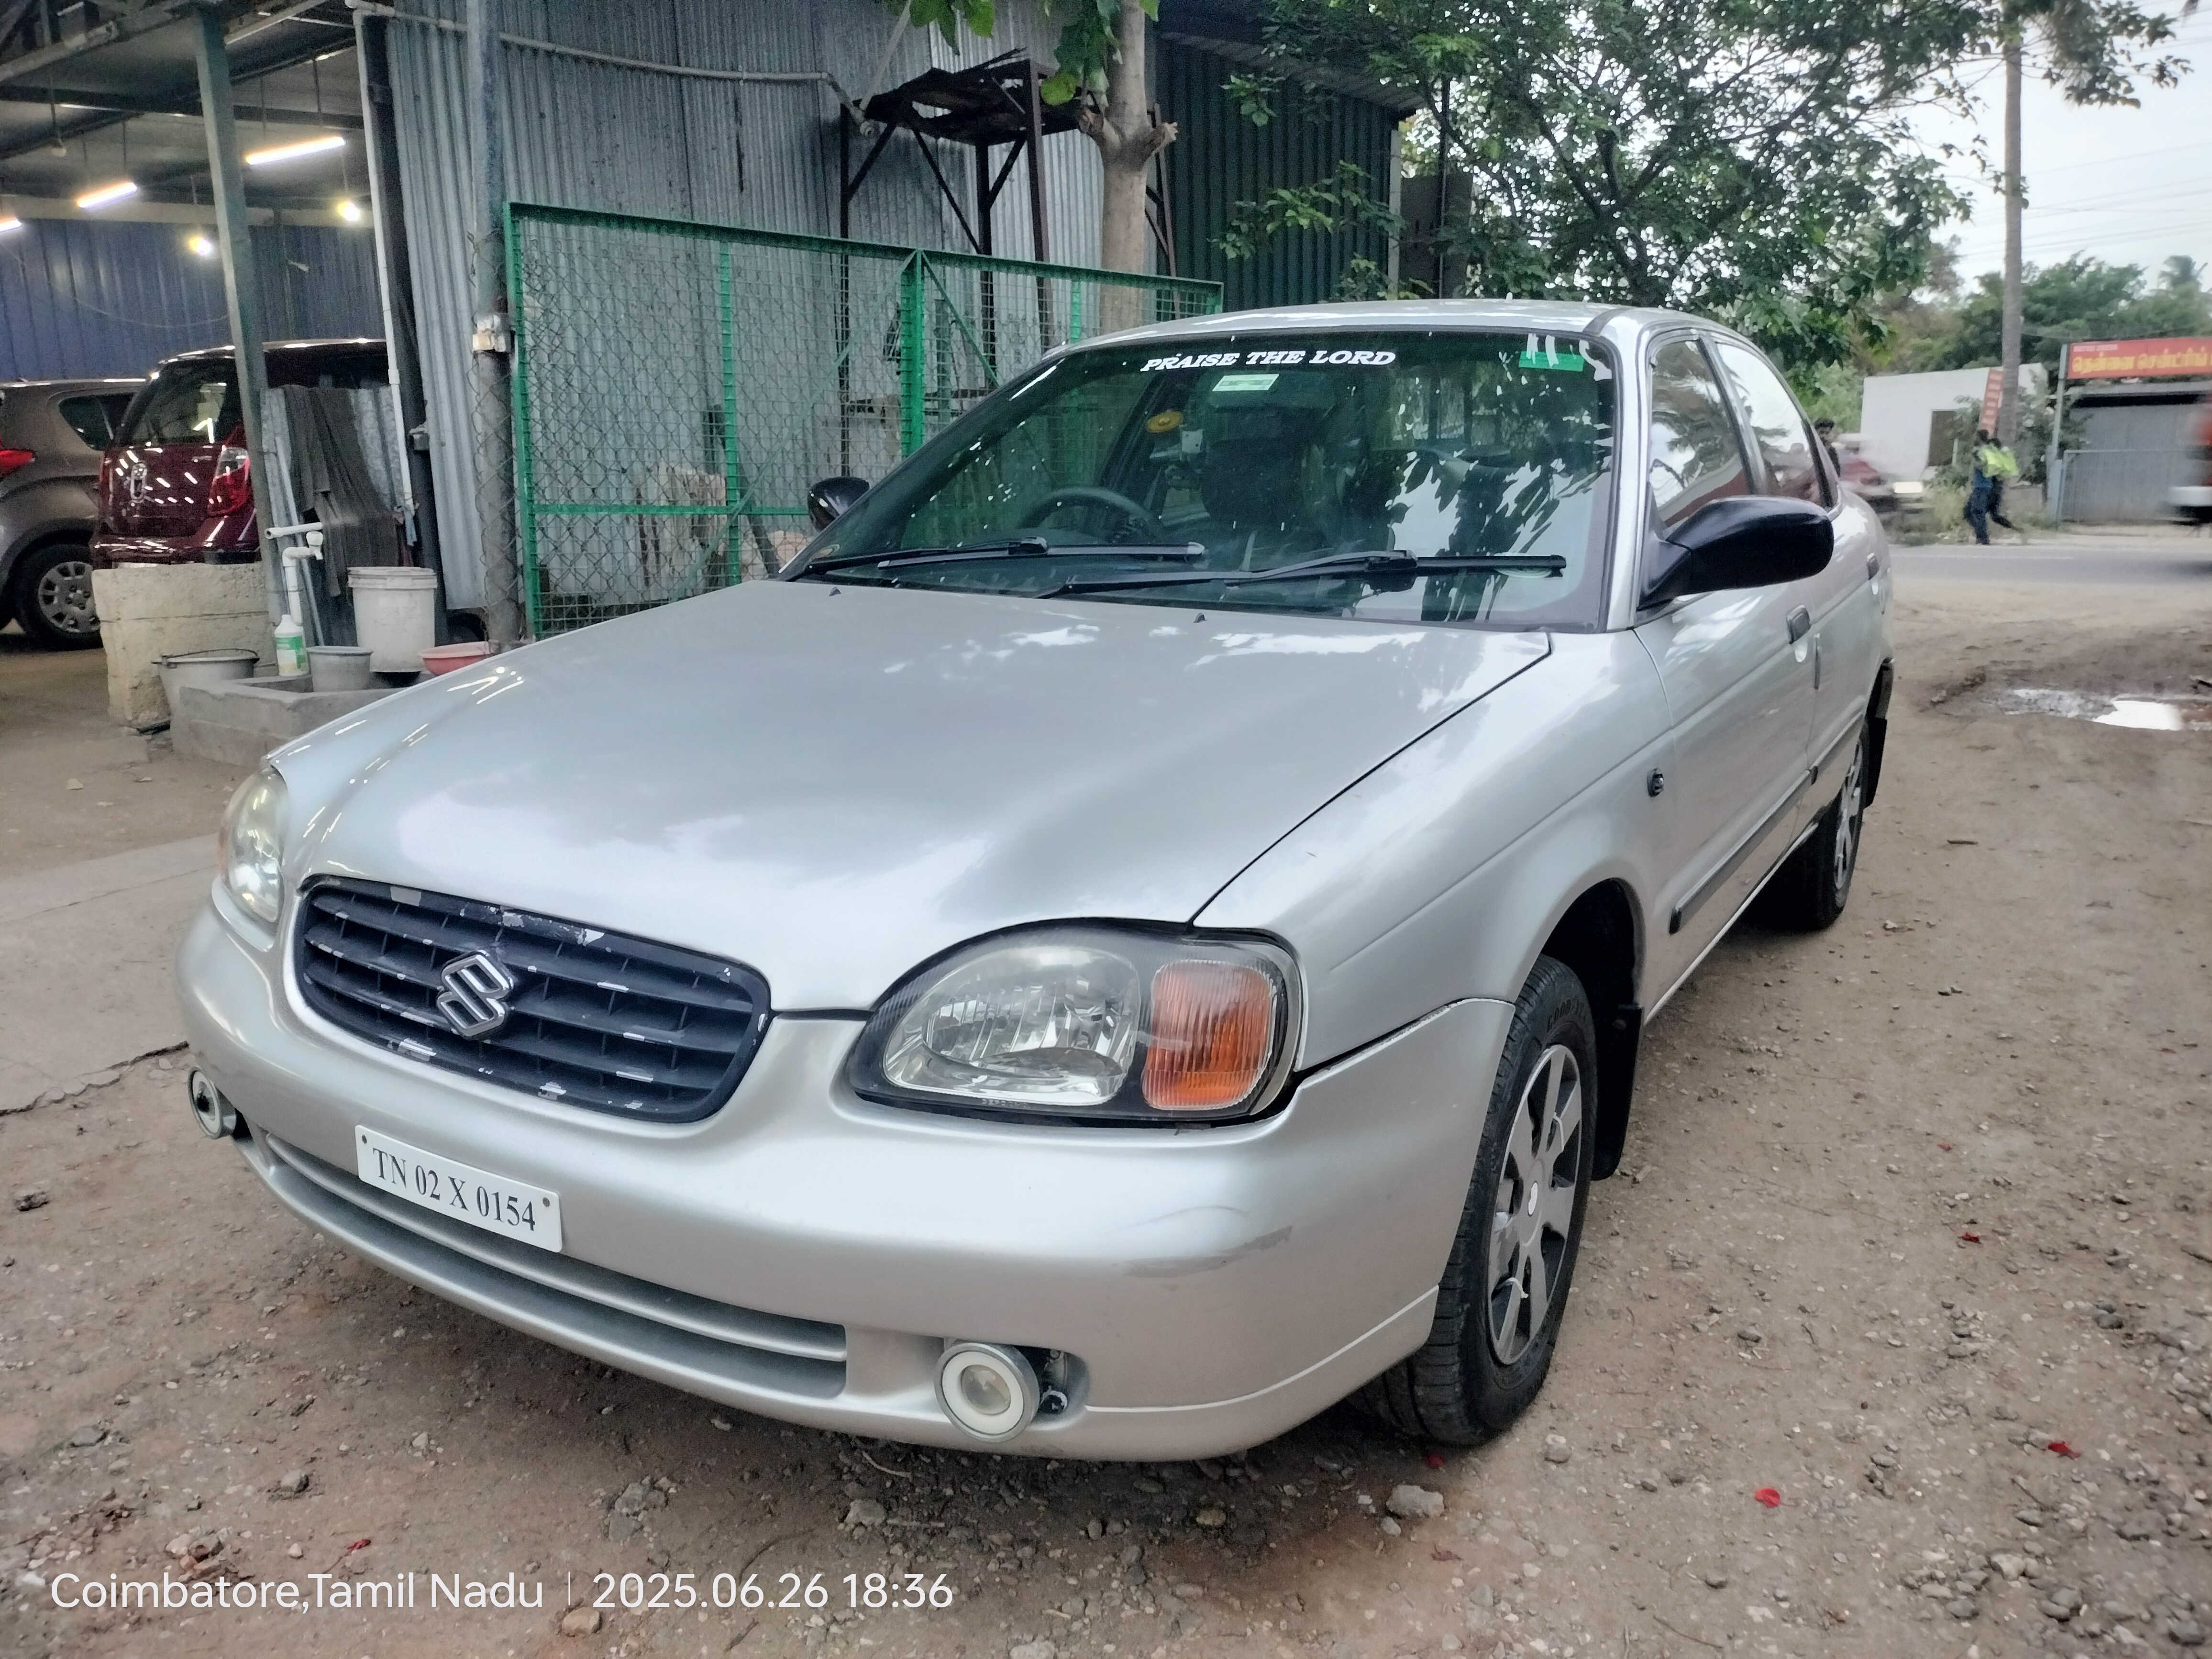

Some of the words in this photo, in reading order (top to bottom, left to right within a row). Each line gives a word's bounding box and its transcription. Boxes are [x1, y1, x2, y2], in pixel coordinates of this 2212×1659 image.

[1140, 353, 1240, 372] PRAISE
[1246, 350, 1306, 365] THE
[1309, 350, 1396, 365] LORD
[373, 1147, 407, 1189] TN
[415, 1165, 441, 1201] 02
[448, 1176, 469, 1211] X
[476, 1186, 535, 1231] 0154
